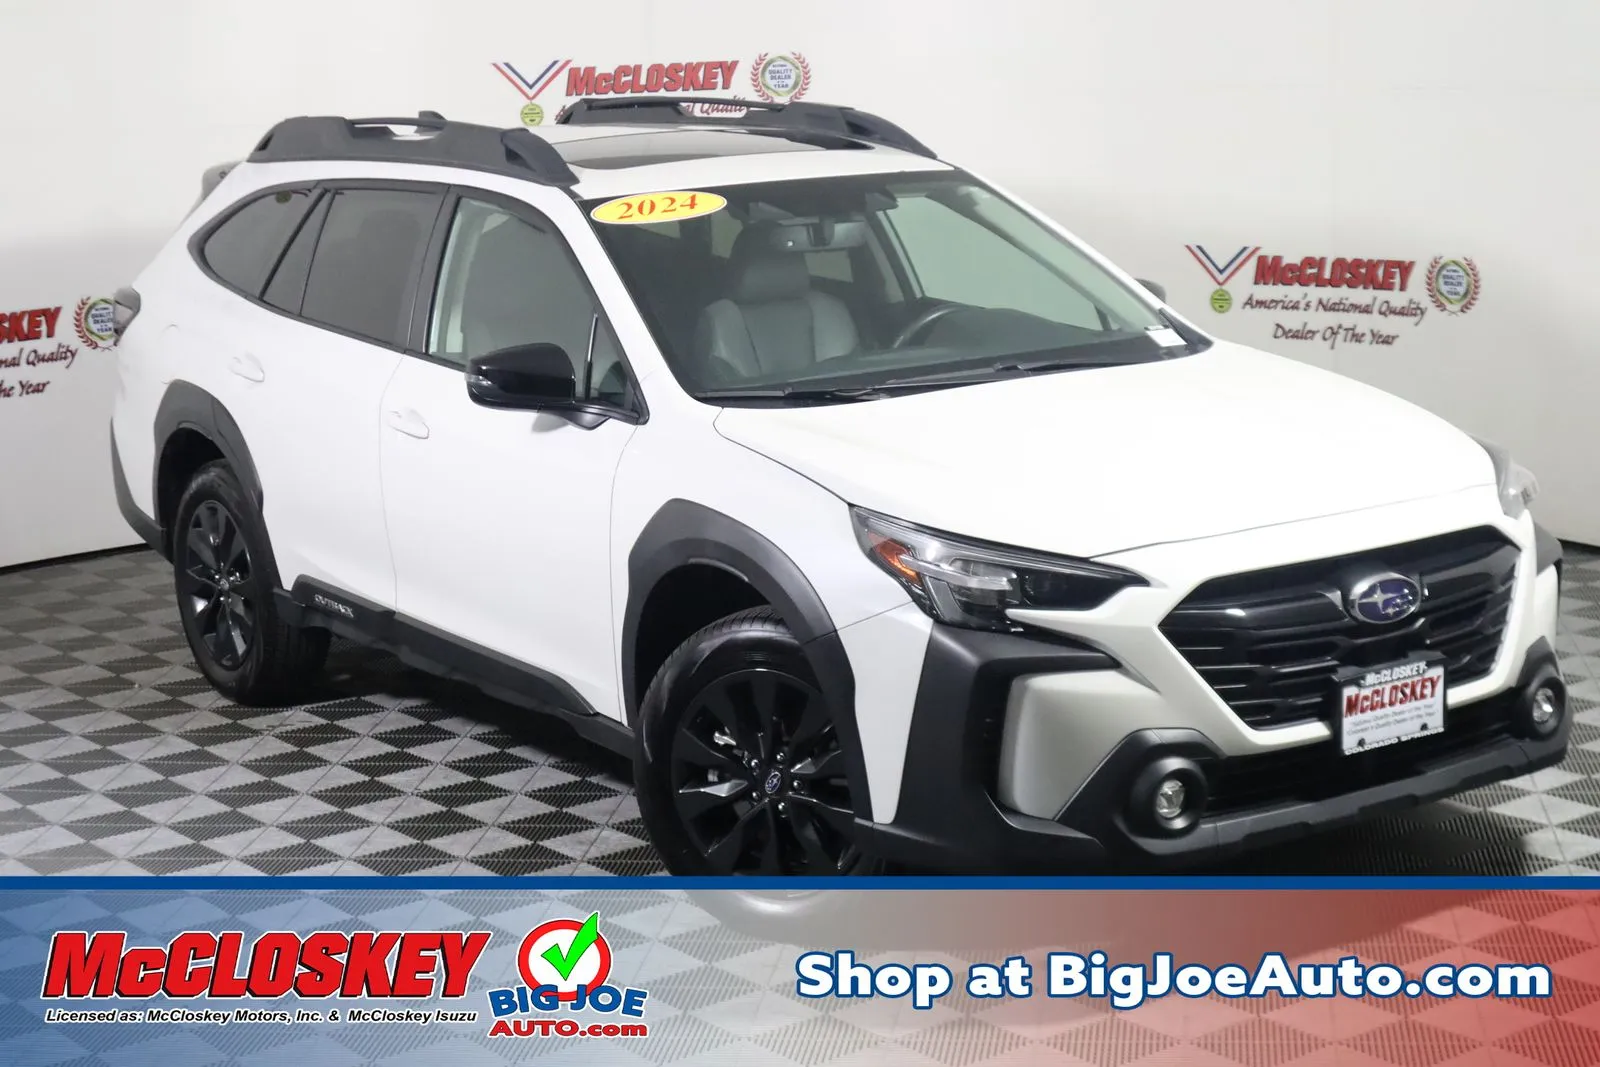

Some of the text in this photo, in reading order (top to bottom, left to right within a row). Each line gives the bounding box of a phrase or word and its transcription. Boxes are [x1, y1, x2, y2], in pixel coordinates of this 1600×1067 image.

[565, 60, 739, 96] McCLOSKEY
[616, 193, 698, 219] 2024
[1254, 255, 1415, 292] McCLOSKEY
[1241, 293, 1311, 312] America's
[1315, 297, 1374, 316] National
[1378, 298, 1427, 326] Quality
[1272, 321, 1400, 350] Dealer Of The Year
[26, 342, 78, 369] Quality
[18, 380, 50, 397] Year
[1345, 675, 1441, 718] McCLOSKEY
